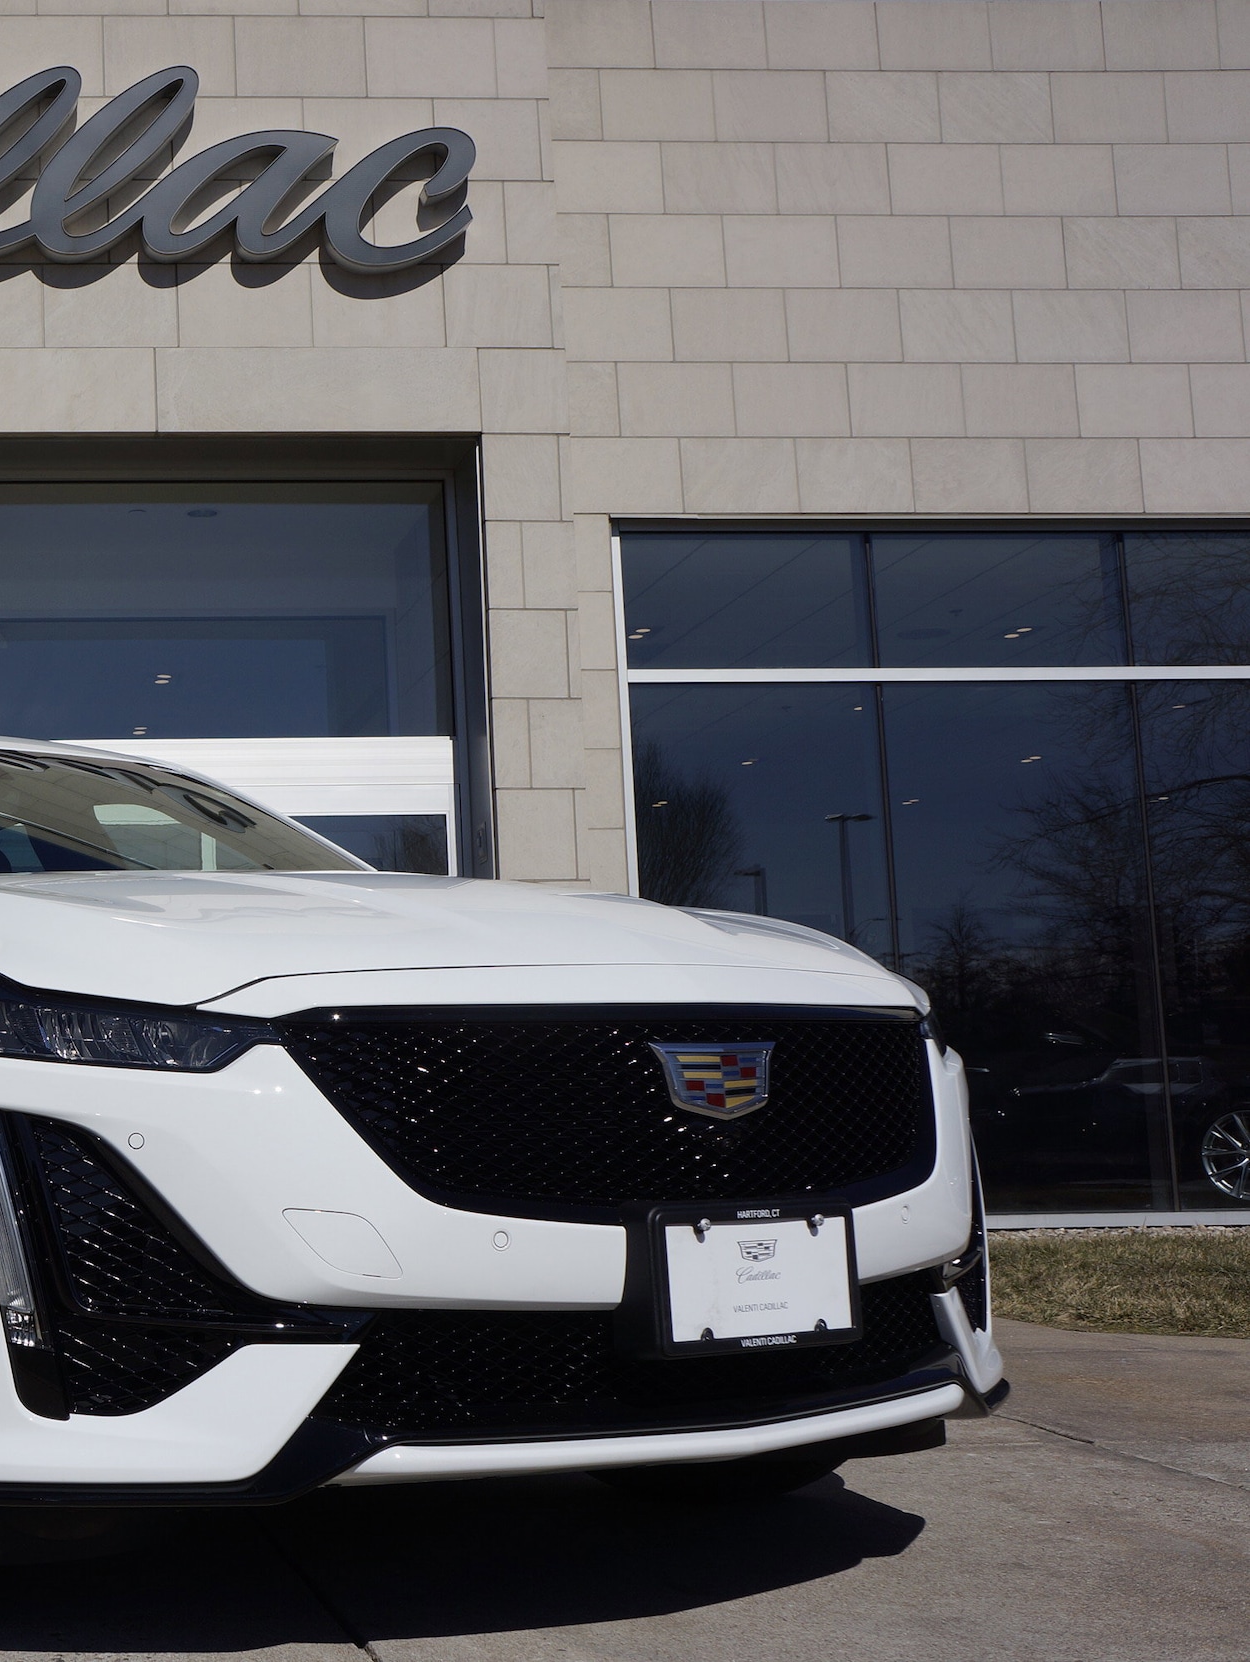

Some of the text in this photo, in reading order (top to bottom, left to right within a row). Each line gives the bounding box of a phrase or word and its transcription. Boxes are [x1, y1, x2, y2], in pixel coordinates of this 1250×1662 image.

[771, 1208, 780, 1218] CT
[736, 1266, 781, 1284] Cadillac
[733, 1301, 789, 1313] VALENTI CADILLAC
[741, 1335, 797, 1347] VALENTI CADILLAC
